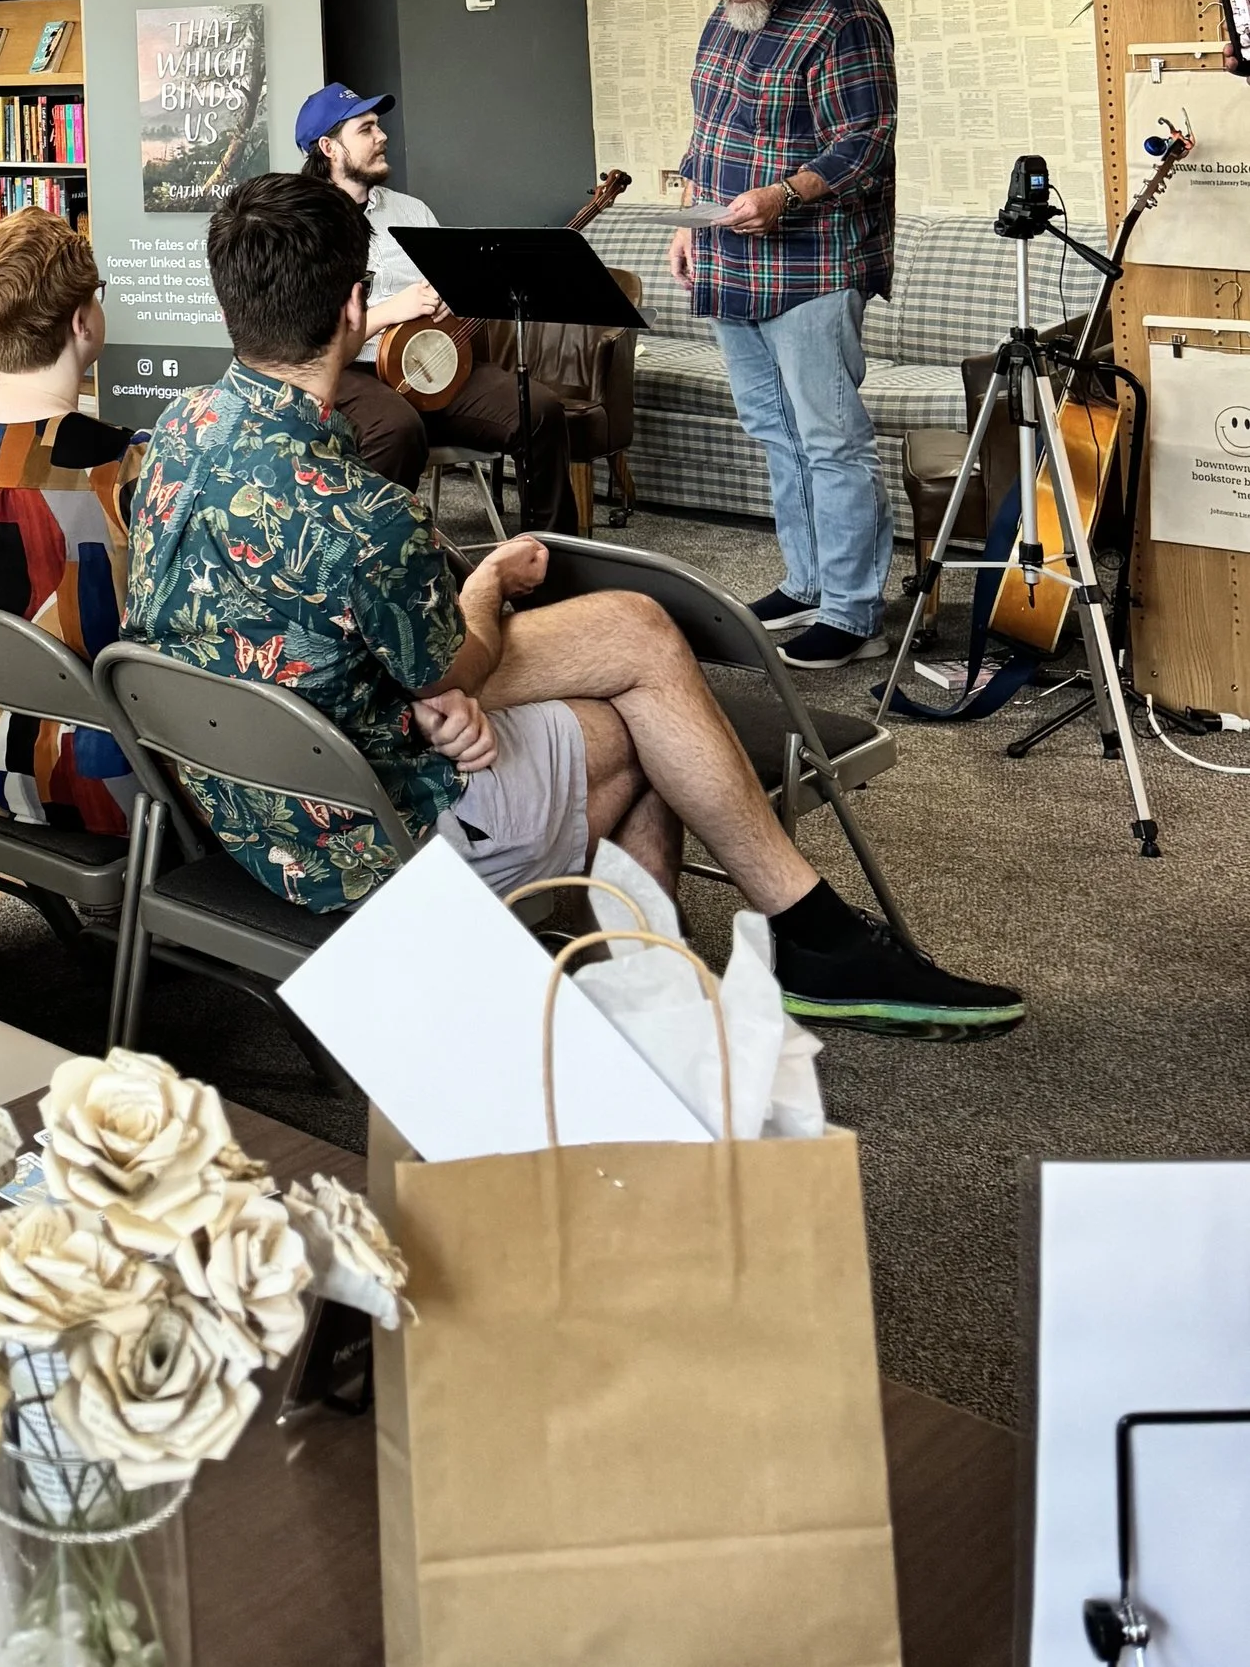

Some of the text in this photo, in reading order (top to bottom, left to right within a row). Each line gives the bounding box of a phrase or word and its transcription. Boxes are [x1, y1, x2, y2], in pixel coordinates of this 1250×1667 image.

[168, 17, 240, 48] THAT
[156, 49, 247, 79] WHICH
[160, 79, 244, 112] BINDS
[184, 111, 218, 145] US
[1200, 164, 1213, 173] to
[1217, 162, 1250, 174] book
[169, 184, 205, 200] CATHY
[129, 239, 152, 251] The
[154, 239, 184, 251] fates
[186, 239, 199, 251] of
[106, 256, 147, 268] forever
[150, 256, 185, 268] linked
[188, 260, 202, 269] as
[109, 273, 210, 287] loss, and the cost
[120, 291, 217, 305] against the strife
[137, 309, 223, 324] an unimaginab
[1191, 471, 1242, 486] bookstore
